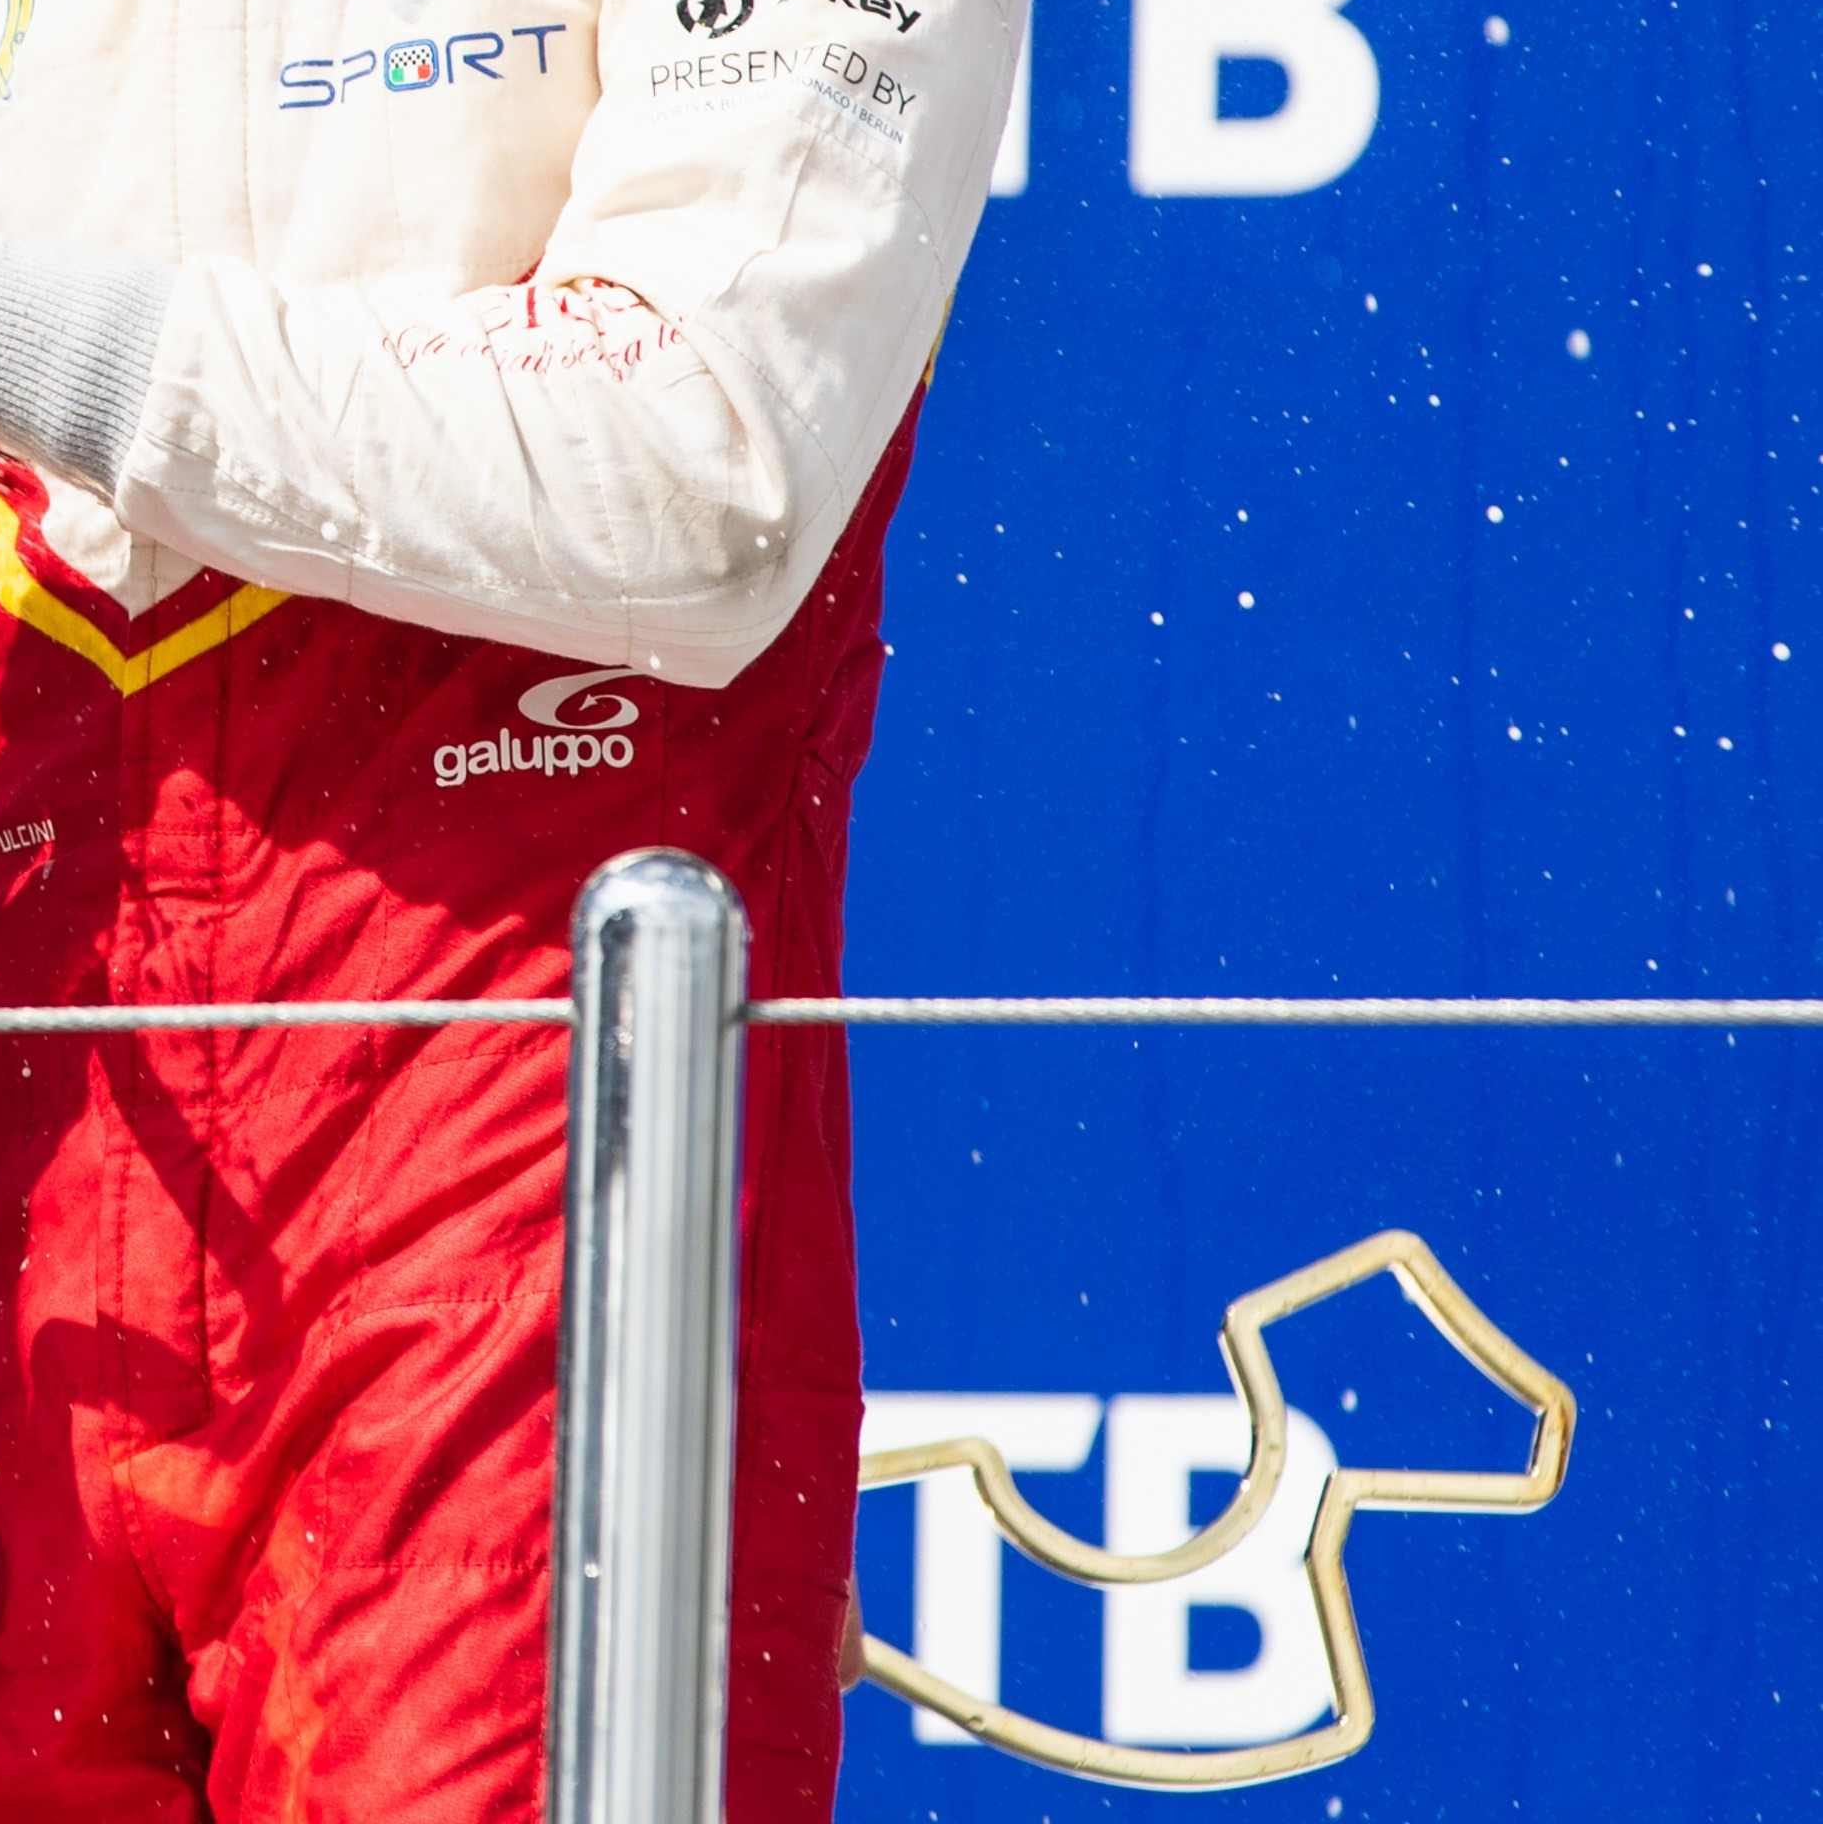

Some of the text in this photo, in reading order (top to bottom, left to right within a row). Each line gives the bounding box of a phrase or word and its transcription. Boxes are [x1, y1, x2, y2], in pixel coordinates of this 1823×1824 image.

[651, 43, 917, 116] PRESENTED BY
[858, 107, 905, 146] BERLIN
[434, 725, 634, 787] galuppo
